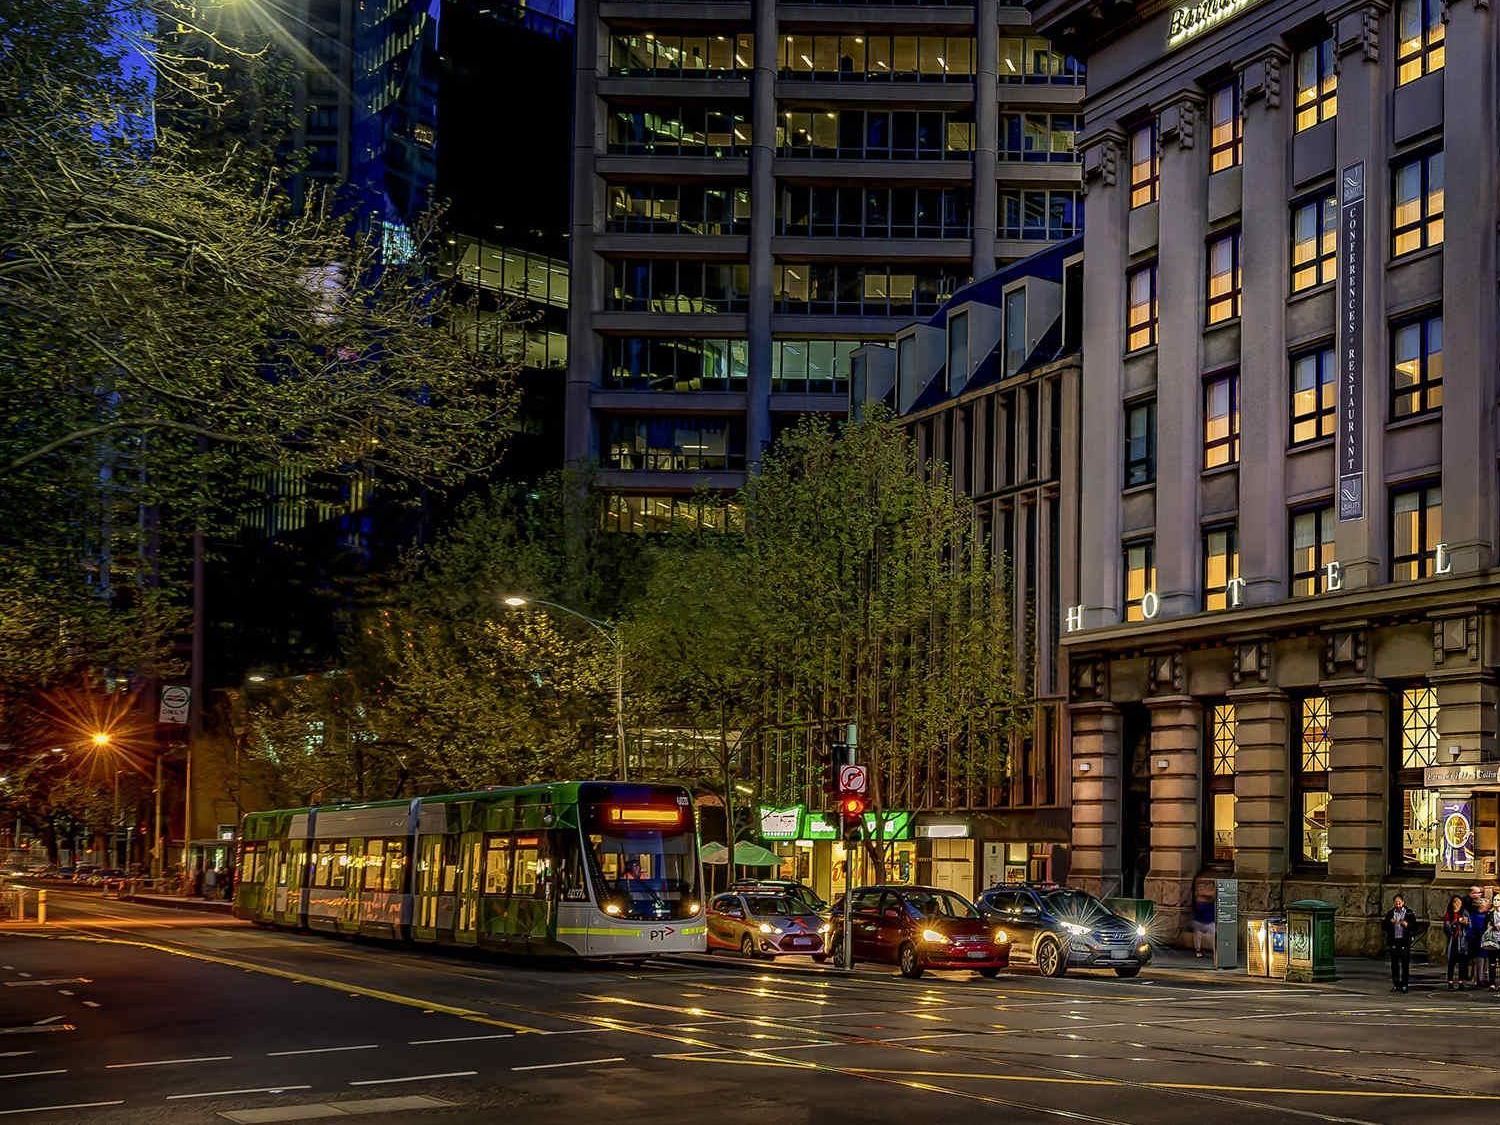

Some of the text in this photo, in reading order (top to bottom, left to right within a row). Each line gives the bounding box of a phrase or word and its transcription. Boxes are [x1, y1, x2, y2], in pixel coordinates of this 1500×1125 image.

[1349, 208, 1357, 332] CONFERENCES
[1348, 349, 1356, 469] RESTAURANT
[1065, 543, 1451, 633] HOTEL
